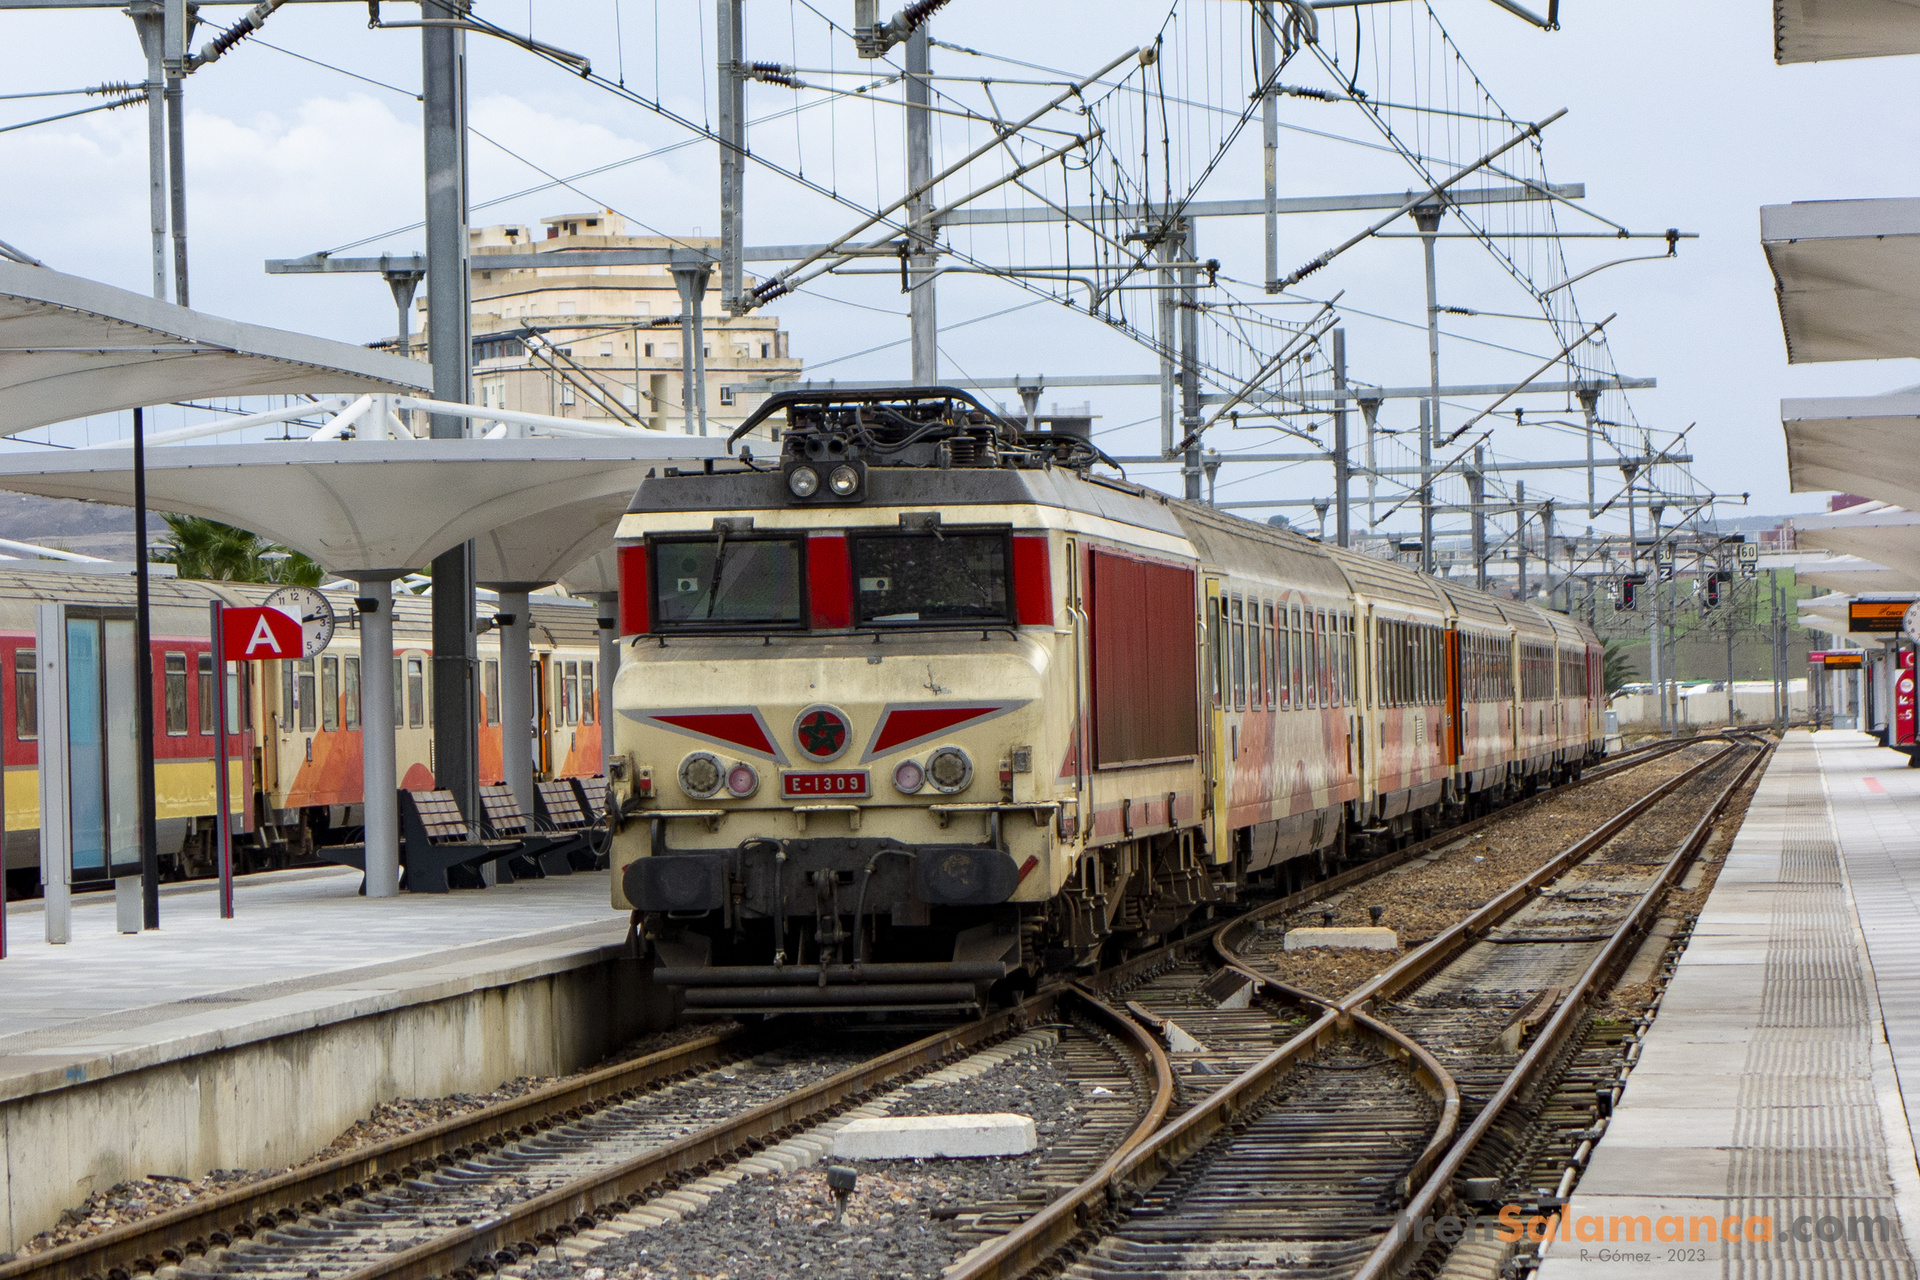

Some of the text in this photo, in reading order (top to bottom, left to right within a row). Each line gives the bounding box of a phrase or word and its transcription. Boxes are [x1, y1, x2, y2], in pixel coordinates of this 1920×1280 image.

[1742, 546, 1754, 558] 60
[1660, 568, 1670, 579] Z
[290, 592, 299, 600] 12
[316, 606, 322, 614] 2
[320, 618, 326, 626] 3
[245, 613, 282, 654] A
[316, 632, 321, 640] 4
[306, 642, 312, 650] 5
[1906, 710, 1912, 720] 5
[792, 778, 858, 792] E-1309
